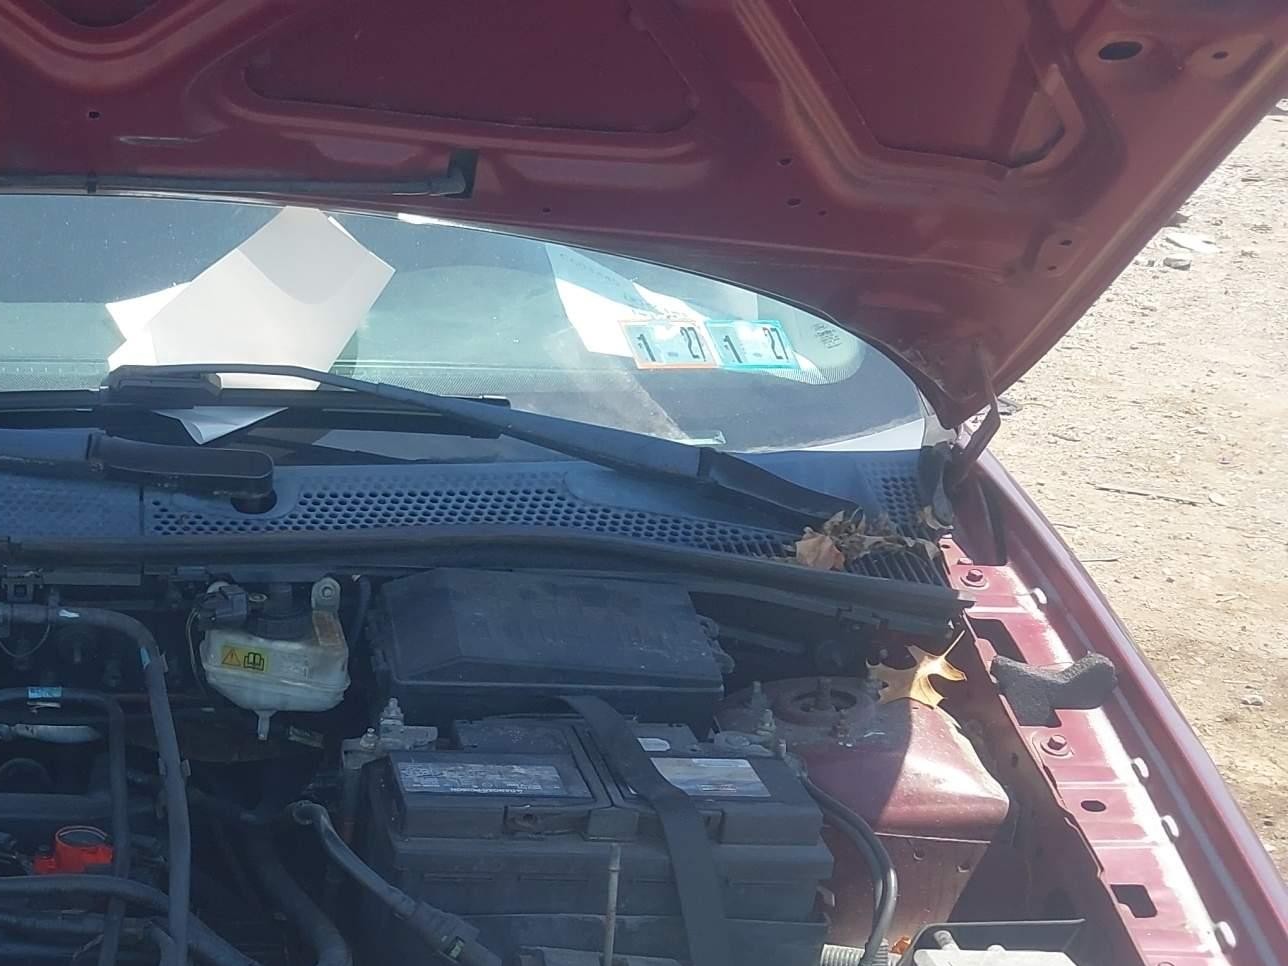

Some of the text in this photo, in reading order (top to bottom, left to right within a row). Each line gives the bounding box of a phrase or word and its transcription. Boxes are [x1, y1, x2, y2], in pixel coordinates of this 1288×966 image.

[638, 326, 706, 362] 1 27
[723, 335, 742, 363] 1
[762, 327, 789, 360] 27
